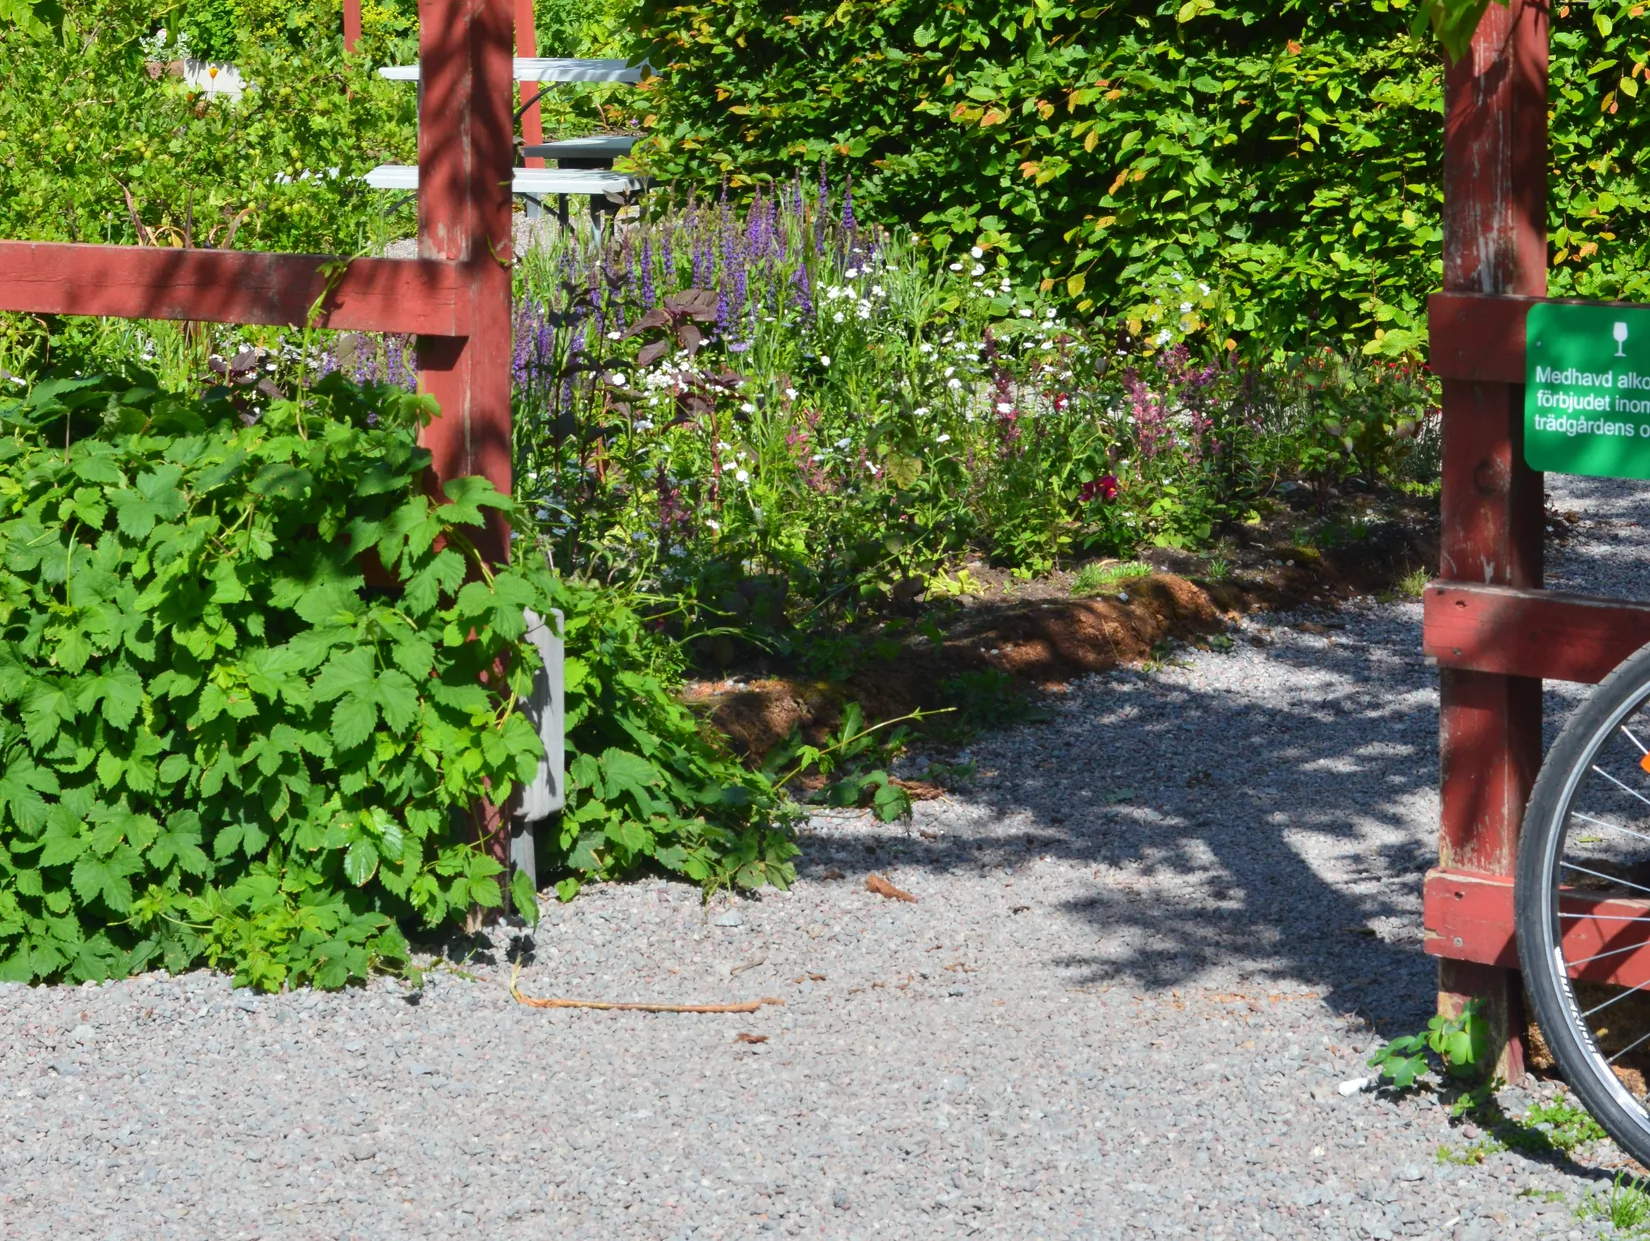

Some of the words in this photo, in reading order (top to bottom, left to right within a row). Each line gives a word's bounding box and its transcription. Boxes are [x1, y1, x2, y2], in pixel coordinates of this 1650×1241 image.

[1535, 365, 1613, 388] Medhavd
[1536, 390, 1610, 412] förbjudet
[1615, 395, 1650, 414] inom
[1534, 414, 1635, 437] trädgårdens
